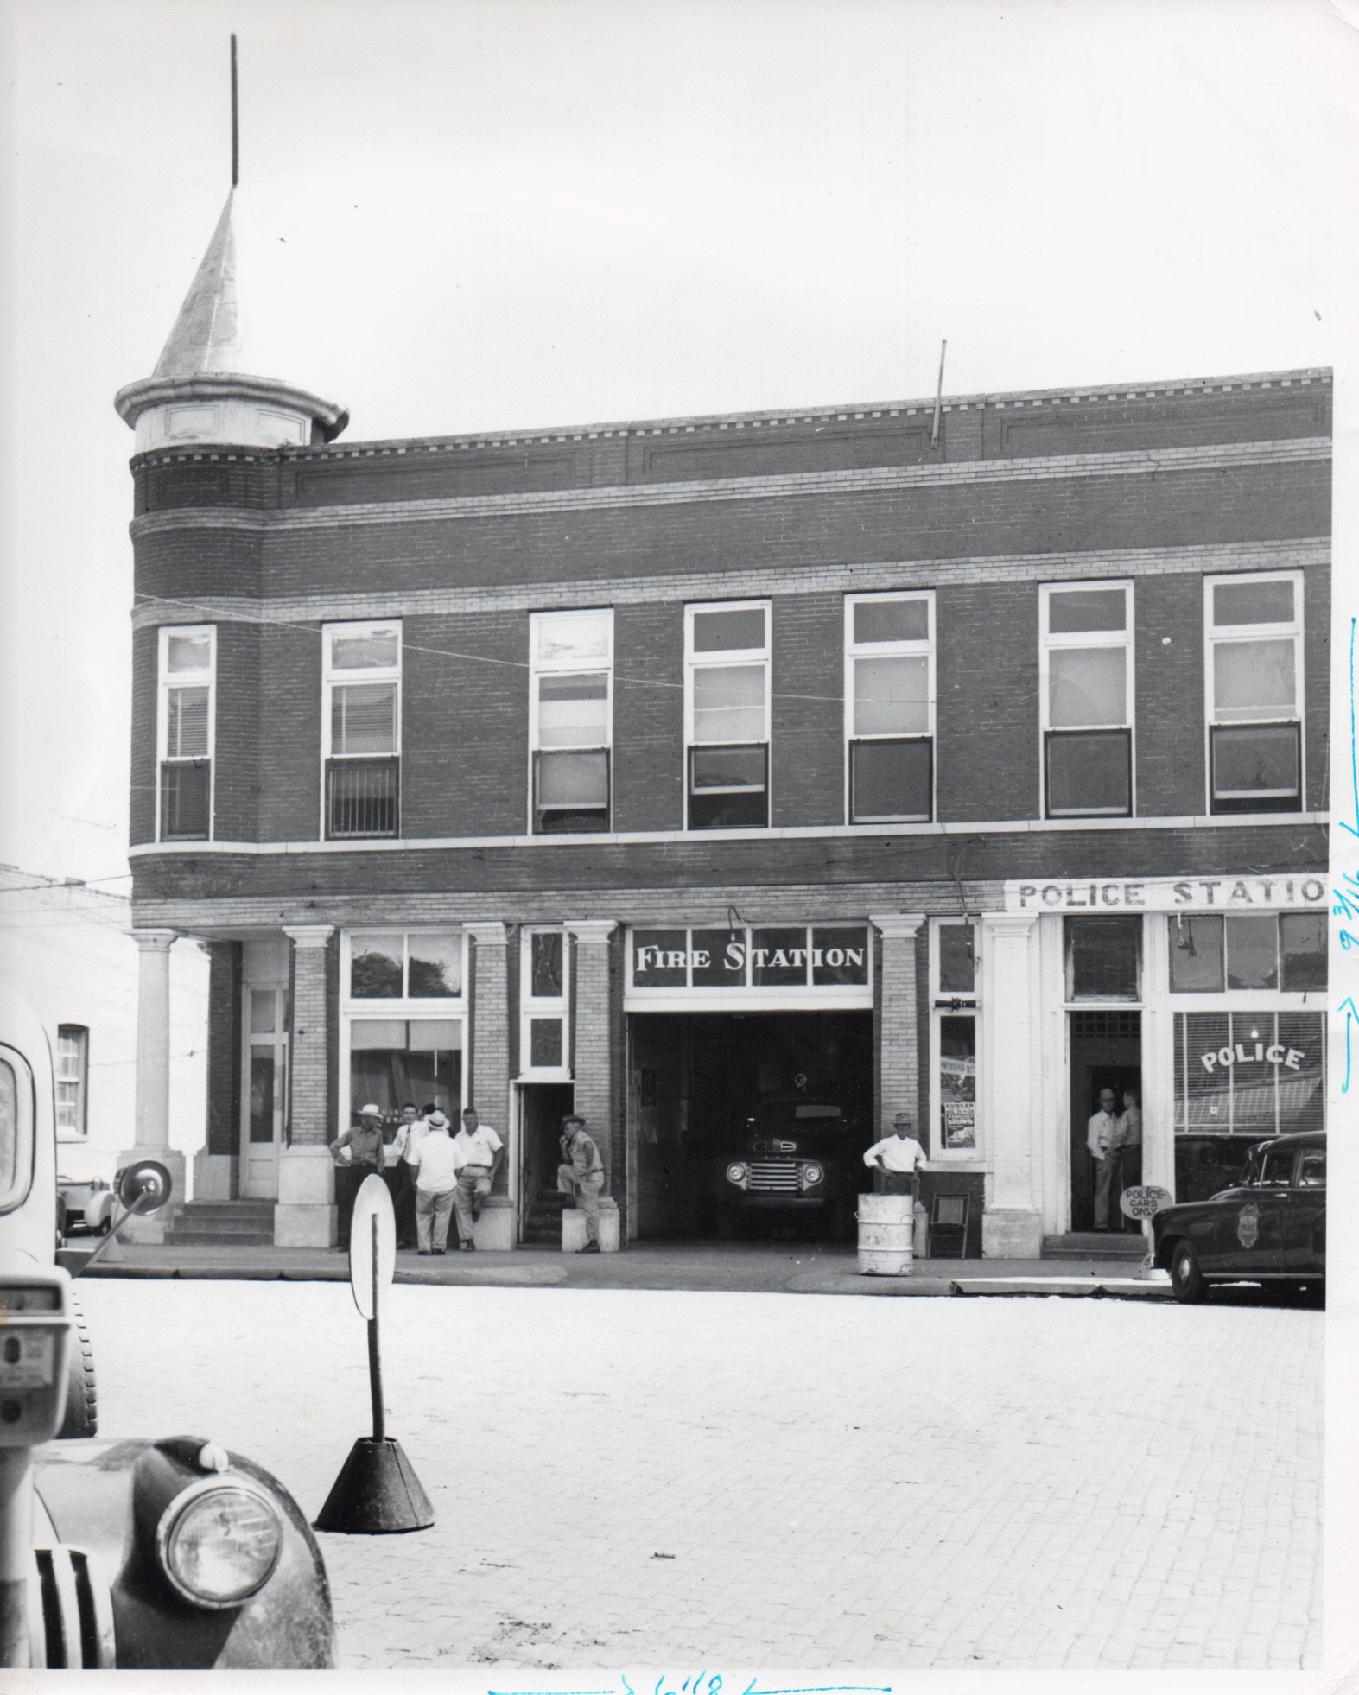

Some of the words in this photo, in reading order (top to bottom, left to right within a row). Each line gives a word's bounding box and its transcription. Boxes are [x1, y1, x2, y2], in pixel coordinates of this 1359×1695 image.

[1019, 883, 1146, 908] POLICE
[1173, 878, 1325, 906] STATIO
[636, 944, 711, 972] FIRE
[723, 942, 865, 971] STATION
[1200, 1043, 1306, 1074] POLICE
[1126, 1189, 1166, 1199] POLICE
[1129, 1199, 1158, 1207] CARS
[1132, 1207, 1159, 1217] ONLY
